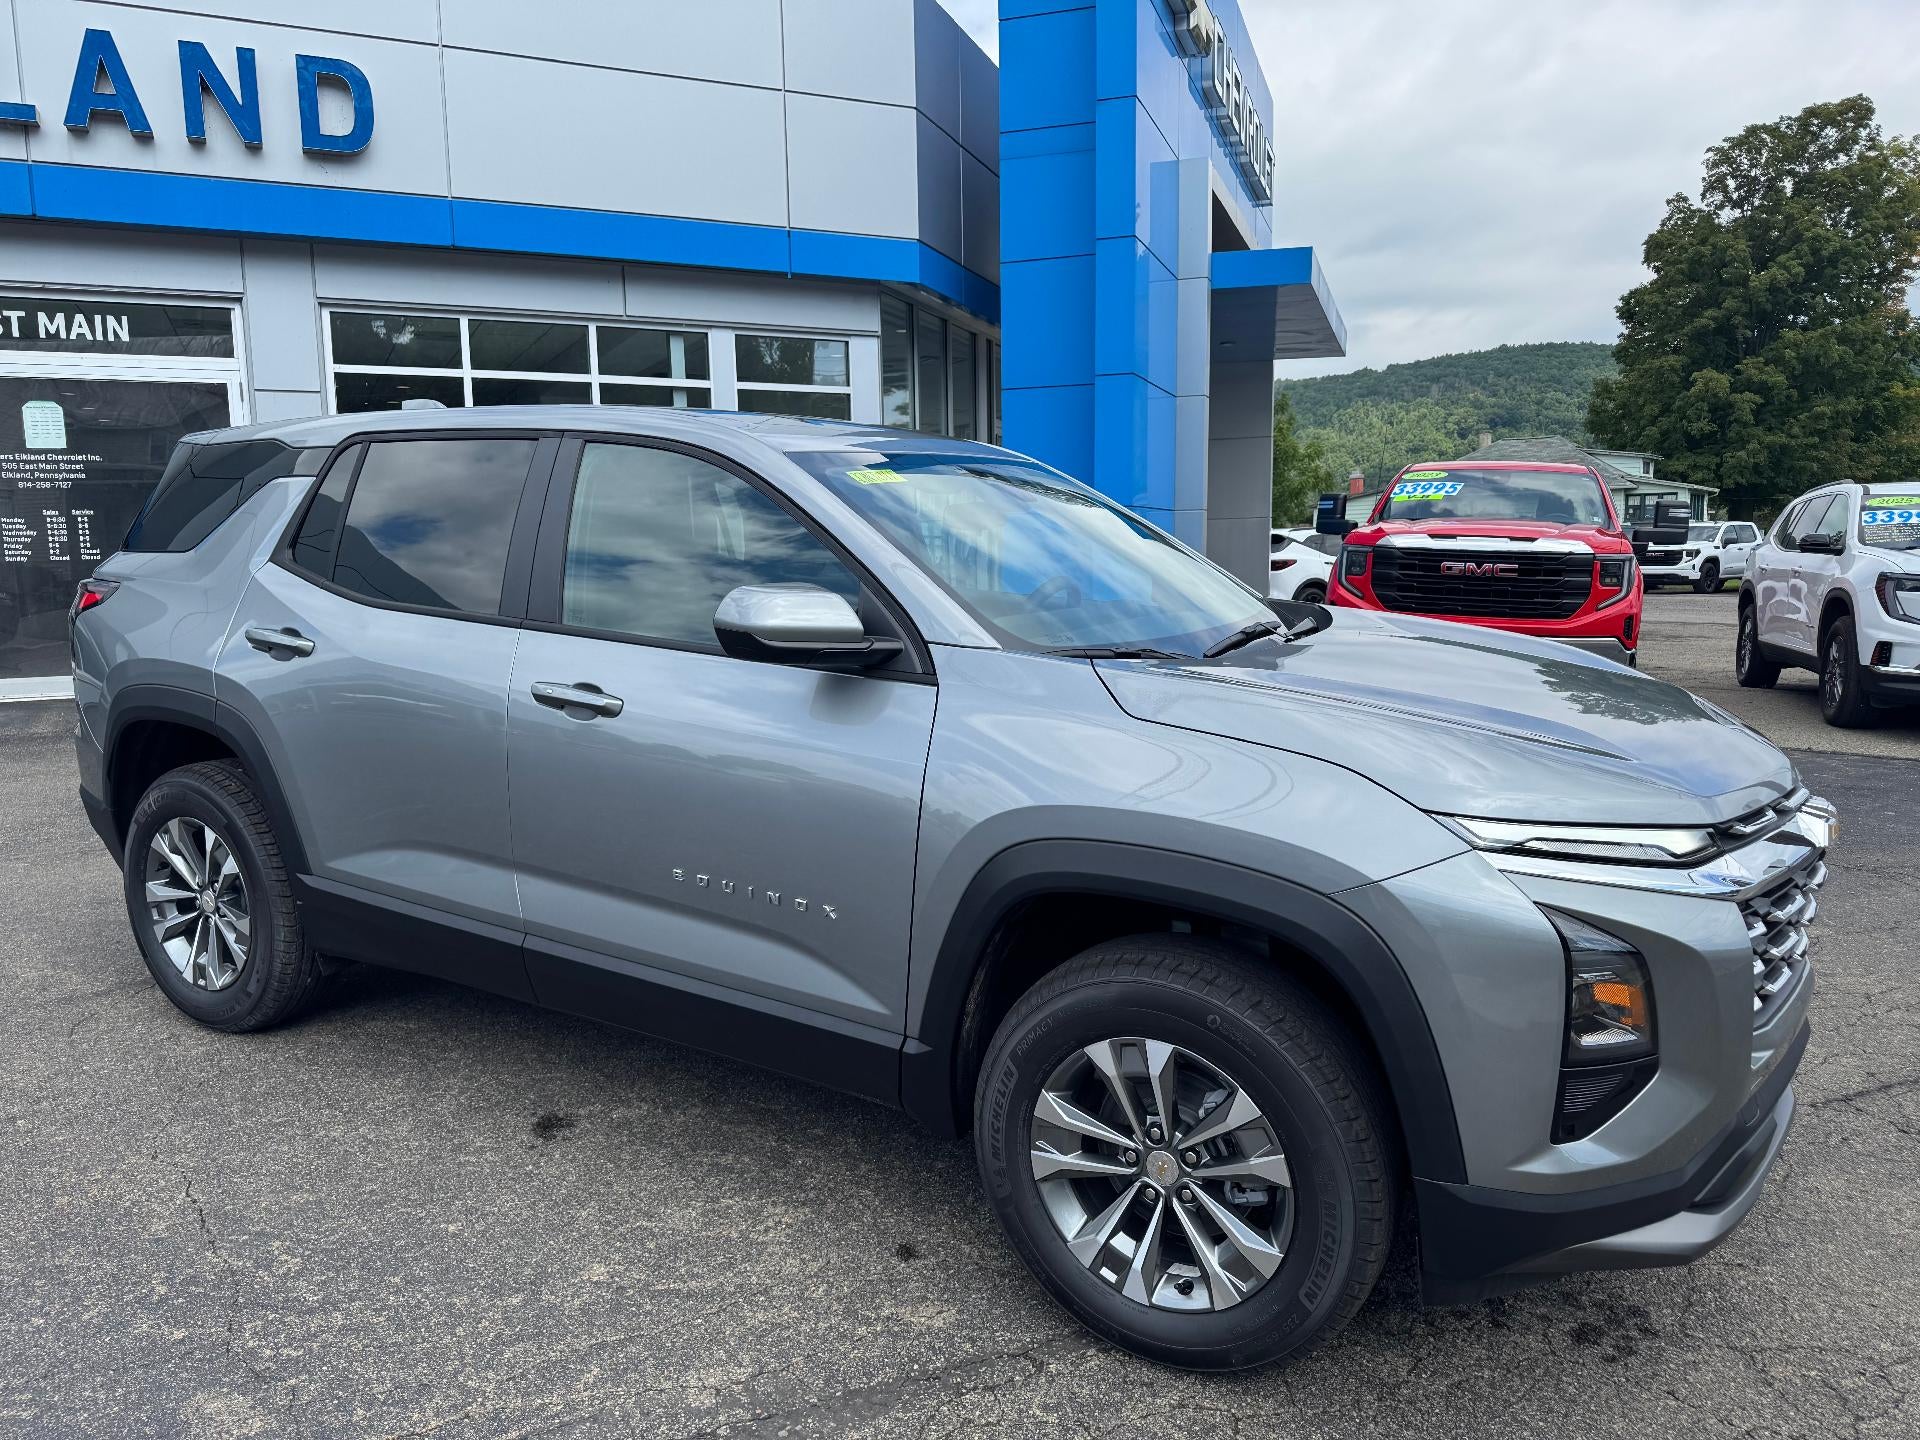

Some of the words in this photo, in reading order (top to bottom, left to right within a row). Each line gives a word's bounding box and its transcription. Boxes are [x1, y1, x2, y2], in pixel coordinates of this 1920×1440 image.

[37, 311, 130, 342] MAIN
[15, 453, 46, 461] Elkland
[47, 453, 88, 461] Chevrolet
[2, 462, 17, 470] 505
[20, 462, 38, 470] East
[39, 462, 58, 470] Main
[60, 462, 84, 470] Street
[2, 471, 34, 479] Elkland,
[35, 471, 86, 480] Pennsylvania
[18, 481, 72, 489] 814-258-7127
[1393, 483, 1462, 496] 33995
[1863, 511, 1920, 525] 339
[1440, 561, 1519, 578] GMC
[672, 868, 837, 919] EQUINOX
[989, 1067, 1016, 1163] MICHELIN
[1302, 1200, 1338, 1308] MICHELIN
